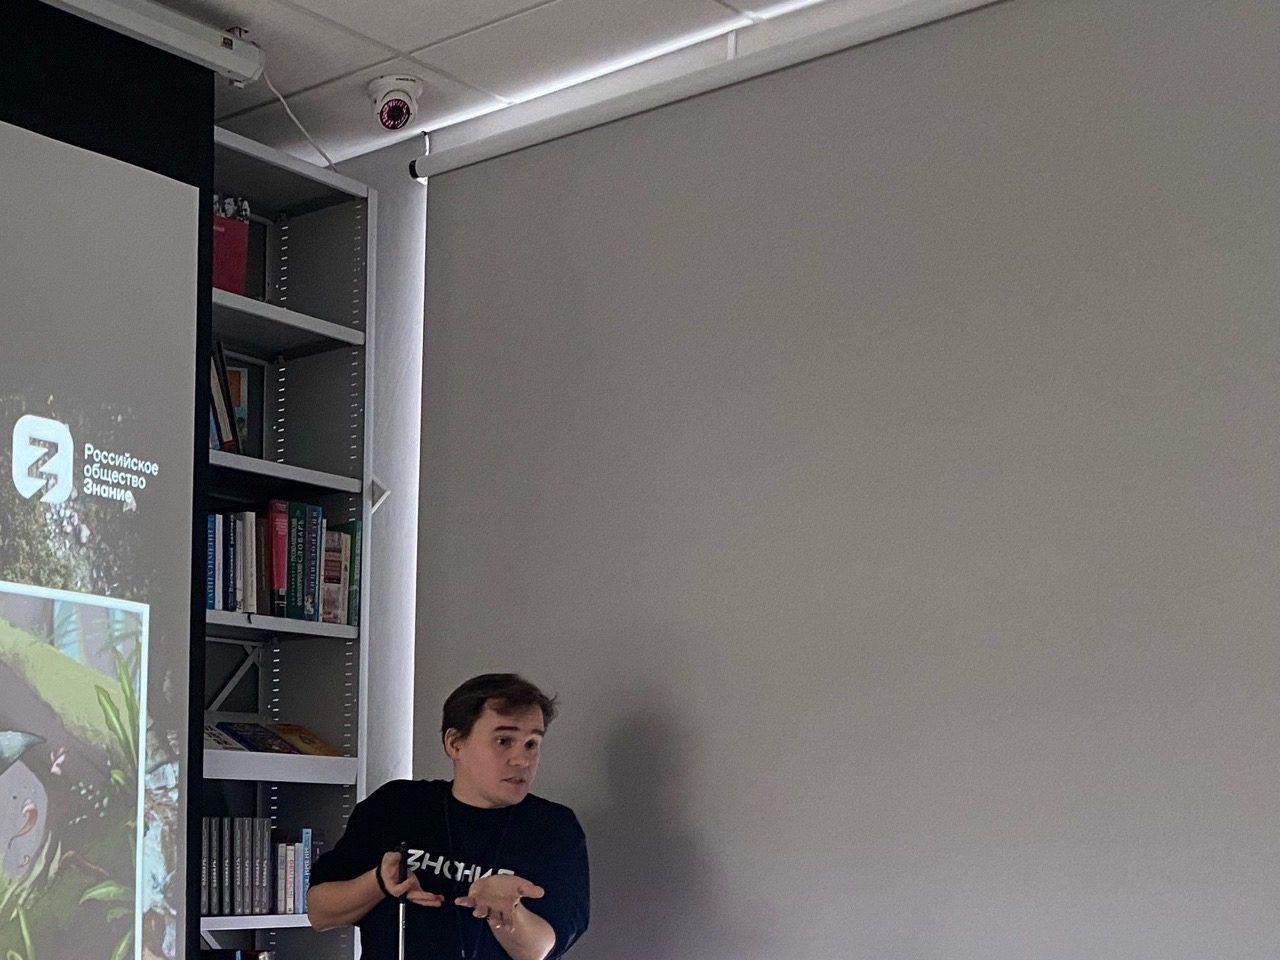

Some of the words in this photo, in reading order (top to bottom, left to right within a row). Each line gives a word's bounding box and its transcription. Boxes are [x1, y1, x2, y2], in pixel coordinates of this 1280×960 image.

[84, 443, 159, 475] Российское
[83, 463, 146, 489] общество
[83, 478, 133, 502] Знание
[407, 849, 515, 883] ЗНАНИ
